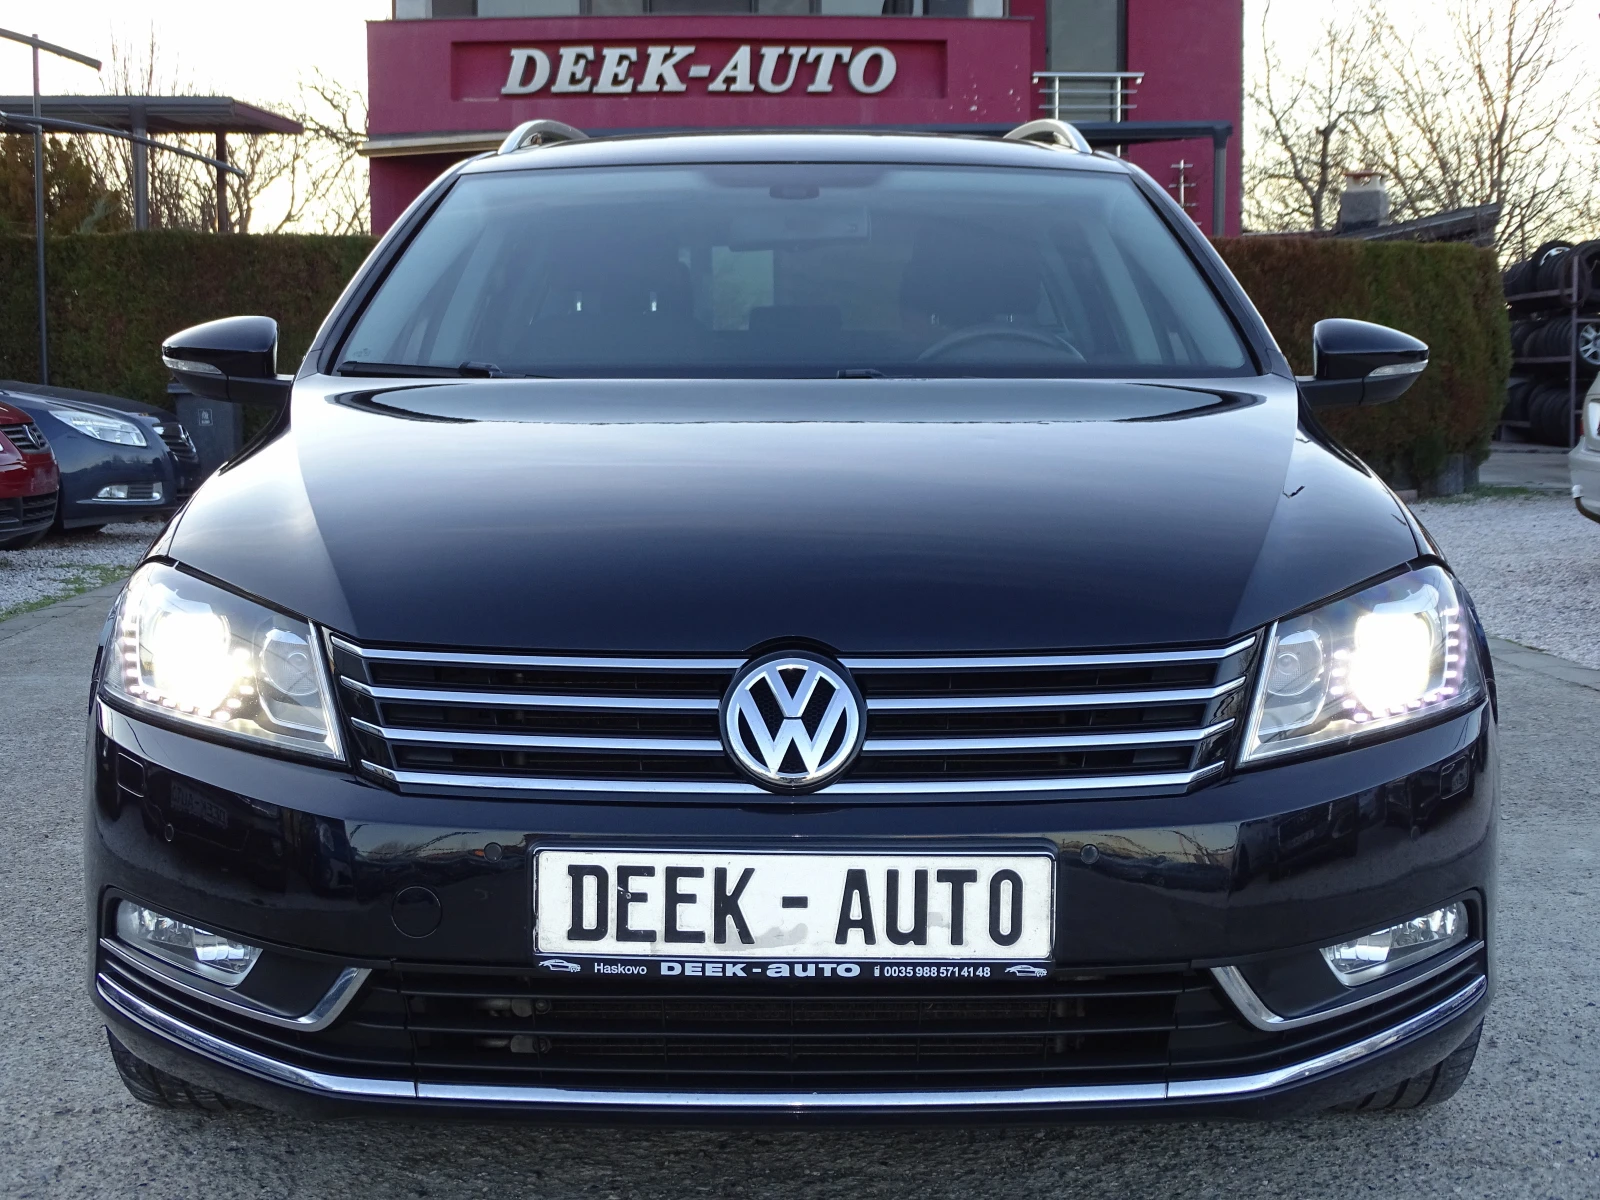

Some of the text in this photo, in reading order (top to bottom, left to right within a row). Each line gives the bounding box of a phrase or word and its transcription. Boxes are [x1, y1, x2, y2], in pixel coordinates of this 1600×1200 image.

[501, 45, 898, 95] DEEK-AUTO
[567, 864, 755, 945] DEEK
[834, 868, 1024, 947] AUTO
[594, 962, 648, 975] Haskovo
[884, 966, 914, 977] 0035
[915, 966, 938, 977] 988
